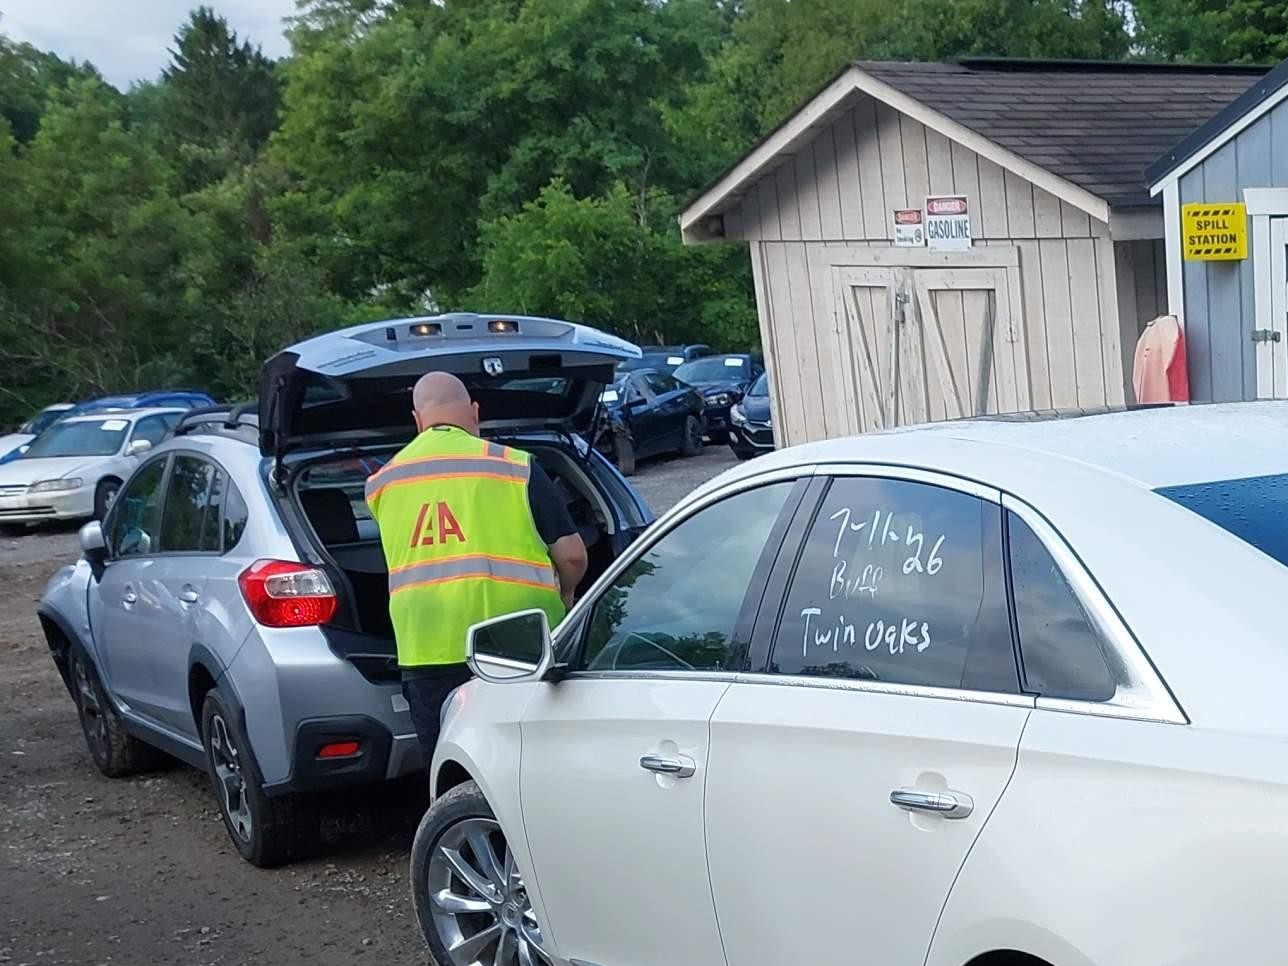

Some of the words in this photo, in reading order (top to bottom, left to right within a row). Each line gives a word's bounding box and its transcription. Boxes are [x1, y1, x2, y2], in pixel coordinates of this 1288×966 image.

[928, 219, 970, 239] GASOLINE
[1196, 219, 1229, 231] SPILL
[1188, 233, 1237, 246] STATION
[801, 607, 855, 656] Twin
